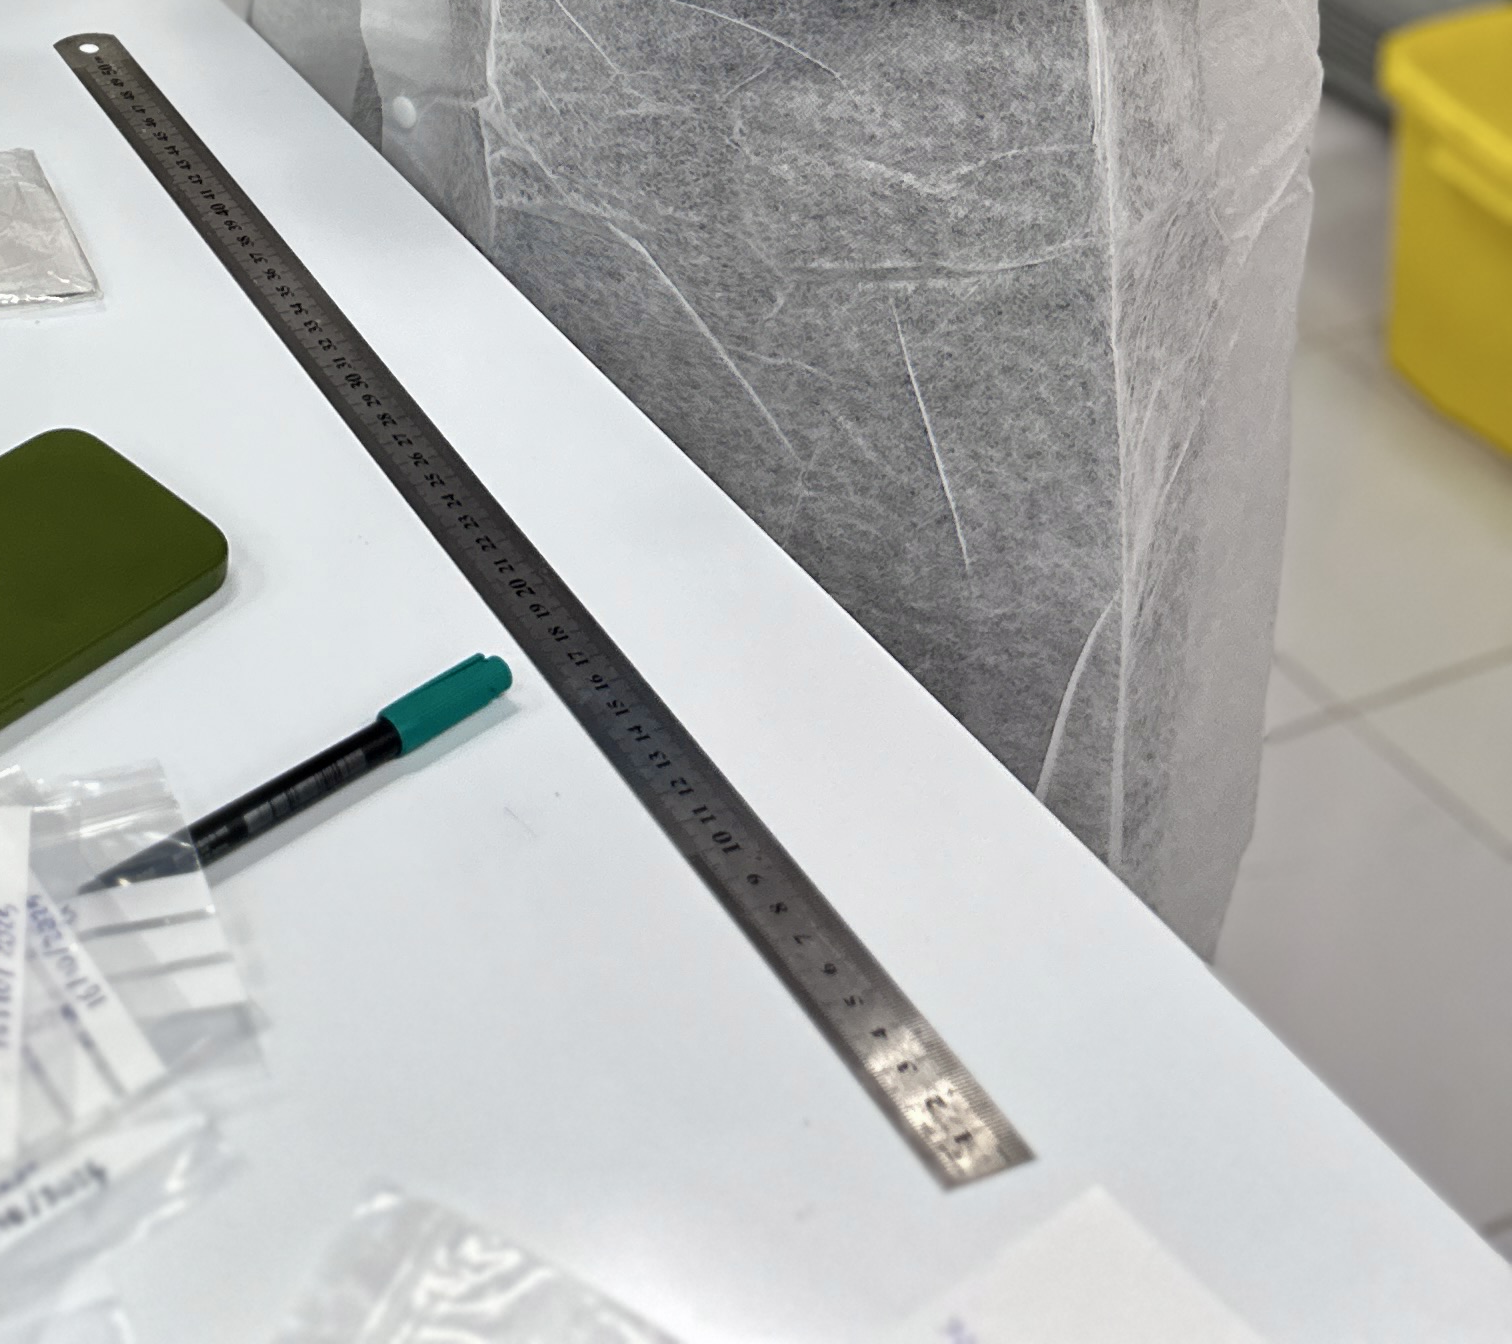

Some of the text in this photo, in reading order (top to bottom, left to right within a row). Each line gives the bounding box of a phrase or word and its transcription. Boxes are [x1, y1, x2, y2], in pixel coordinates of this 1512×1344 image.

[98, 63, 117, 76] 50
[110, 78, 124, 87] 49
[120, 90, 134, 100] 48
[131, 105, 146, 114] 47
[144, 117, 157, 128] 46
[153, 131, 168, 141] 45
[164, 145, 179, 156] 44
[175, 159, 191, 170] 43
[188, 174, 203, 185] 42
[200, 189, 215, 200] 41
[210, 203, 229, 216] 40
[223, 219, 242, 231] 39
[237, 235, 254, 247] 38
[249, 252, 268, 264] 37
[263, 268, 281, 281] 36
[275, 285, 295, 297] 35
[289, 303, 308, 315] 34
[303, 320, 323, 333] 33
[318, 337, 337, 351] 32
[332, 356, 352, 369] 31
[344, 373, 369, 390] 30
[361, 394, 382, 407] 29
[376, 412, 398, 427] 28
[392, 433, 413, 447] 27
[408, 452, 430, 467] 26
[424, 473, 445, 488] 25
[441, 493, 462, 509] 24
[457, 514, 480, 530] 23
[475, 535, 497, 551] 22
[493, 558, 515, 574] 21
[508, 578, 537, 598] 20
[529, 603, 551, 619] 19
[547, 625, 569, 642] 18
[567, 651, 589, 667] 17
[590, 674, 609, 691] 16
[606, 699, 631, 717] 15
[627, 724, 651, 742] 14
[648, 750, 671, 769] 13
[670, 777, 694, 796] 12
[692, 804, 717, 824] 11
[711, 830, 741, 854] 10
[746, 873, 763, 886] 9
[769, 901, 788, 914] 8
[793, 934, 812, 945] 7
[822, 963, 838, 976] 6
[843, 995, 864, 1007] 5
[871, 1027, 888, 1039] 4
[896, 1061, 918, 1074] 3
[925, 1095, 947, 1111] 2
[954, 1130, 973, 1144] 1
